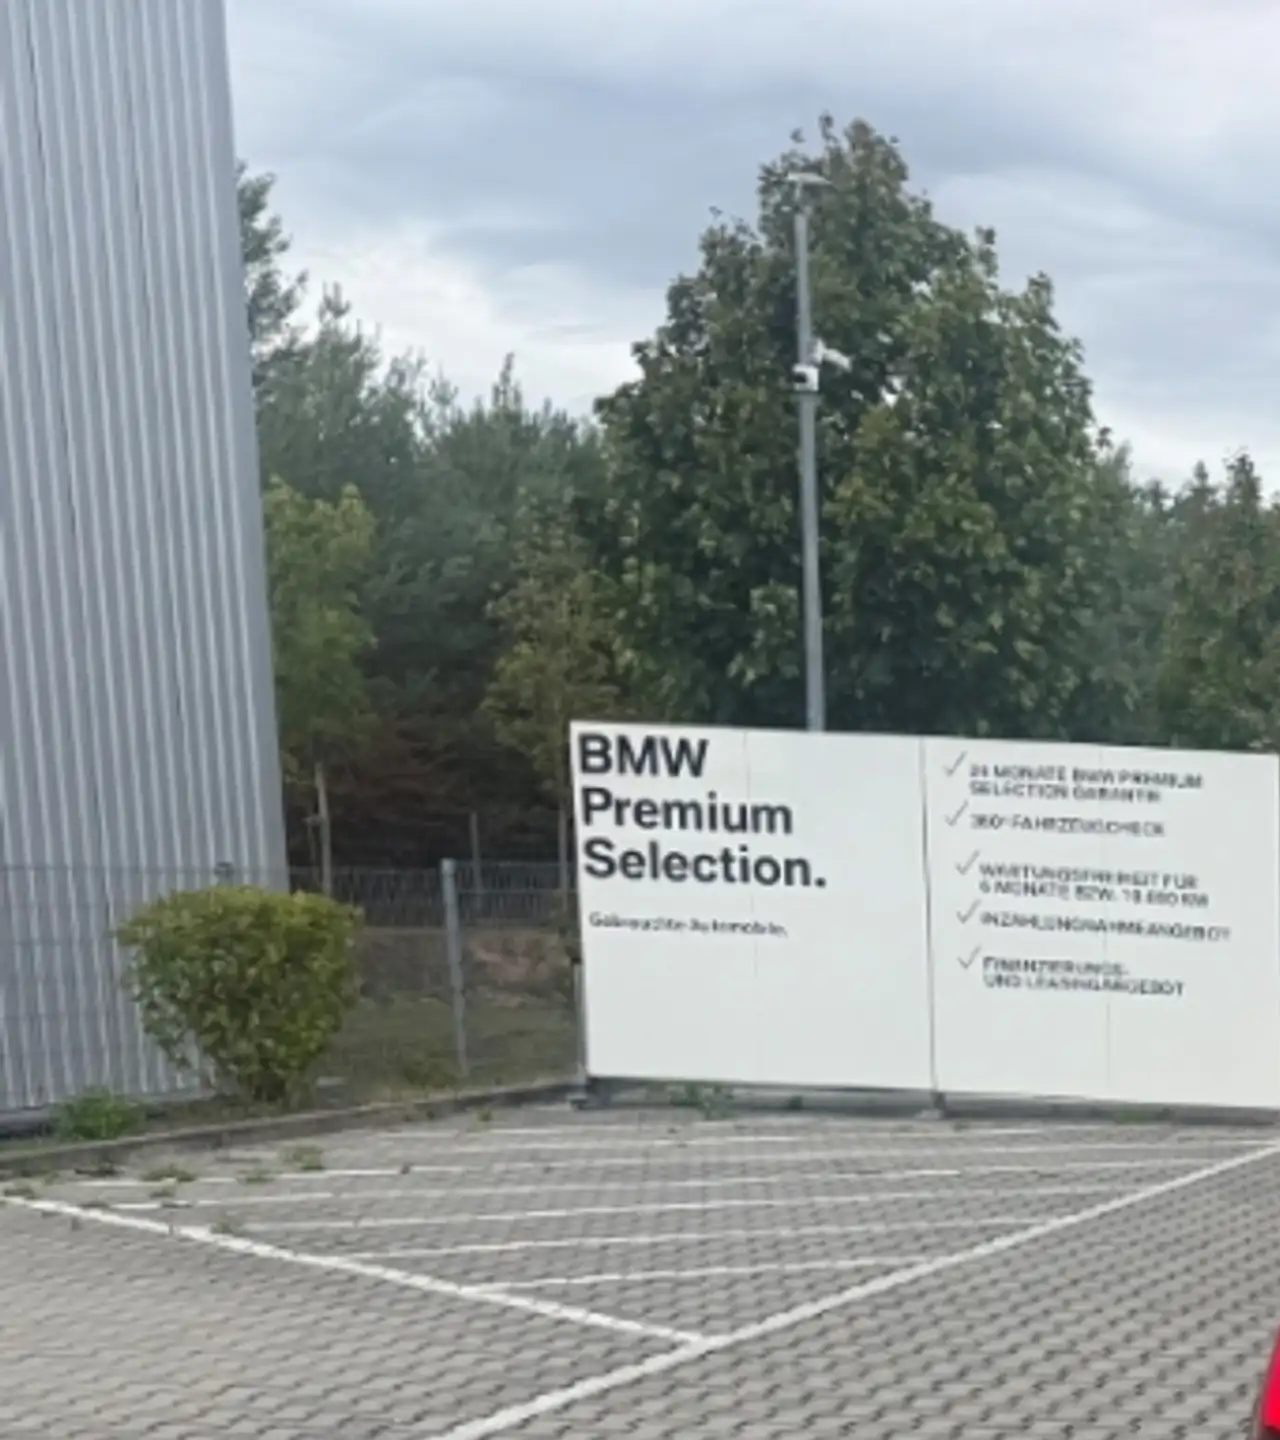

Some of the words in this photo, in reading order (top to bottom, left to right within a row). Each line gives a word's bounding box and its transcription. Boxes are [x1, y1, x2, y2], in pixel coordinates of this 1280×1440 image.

[578, 732, 709, 778] BMW
[581, 785, 792, 834] Premium
[584, 836, 826, 888] Selection.
